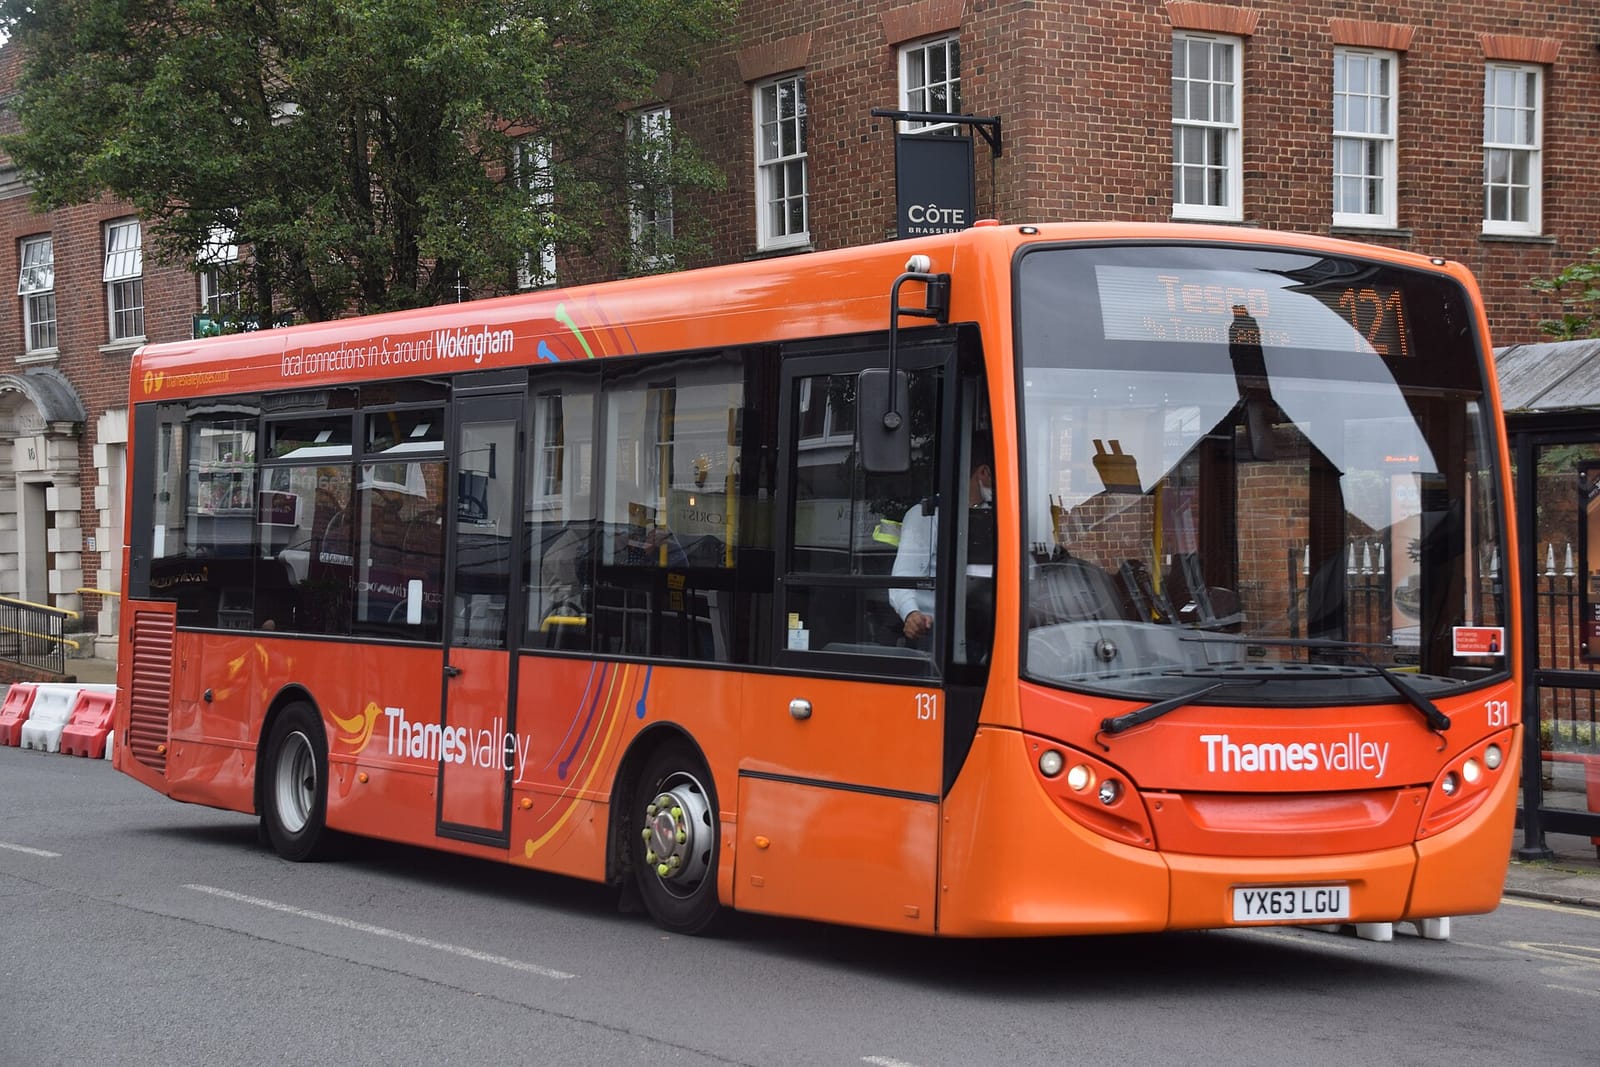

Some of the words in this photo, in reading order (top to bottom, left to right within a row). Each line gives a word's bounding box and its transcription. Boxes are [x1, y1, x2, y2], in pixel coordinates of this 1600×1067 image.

[907, 203, 965, 225] CÔTE
[1157, 275, 1270, 317] Tesco
[1339, 287, 1408, 356] 121
[281, 346, 304, 376] local
[304, 340, 366, 374] connections
[367, 339, 378, 366] in
[380, 337, 391, 365] &
[392, 331, 434, 364] around
[436, 324, 514, 364] Wokingham
[914, 692, 937, 720] 131
[1484, 700, 1508, 727] 131
[384, 707, 467, 764] Thames
[469, 716, 531, 784] valley
[1199, 734, 1318, 772] Thames
[1319, 732, 1389, 779] valley
[1243, 891, 1296, 915] YX63
[1301, 889, 1340, 913] LGU
